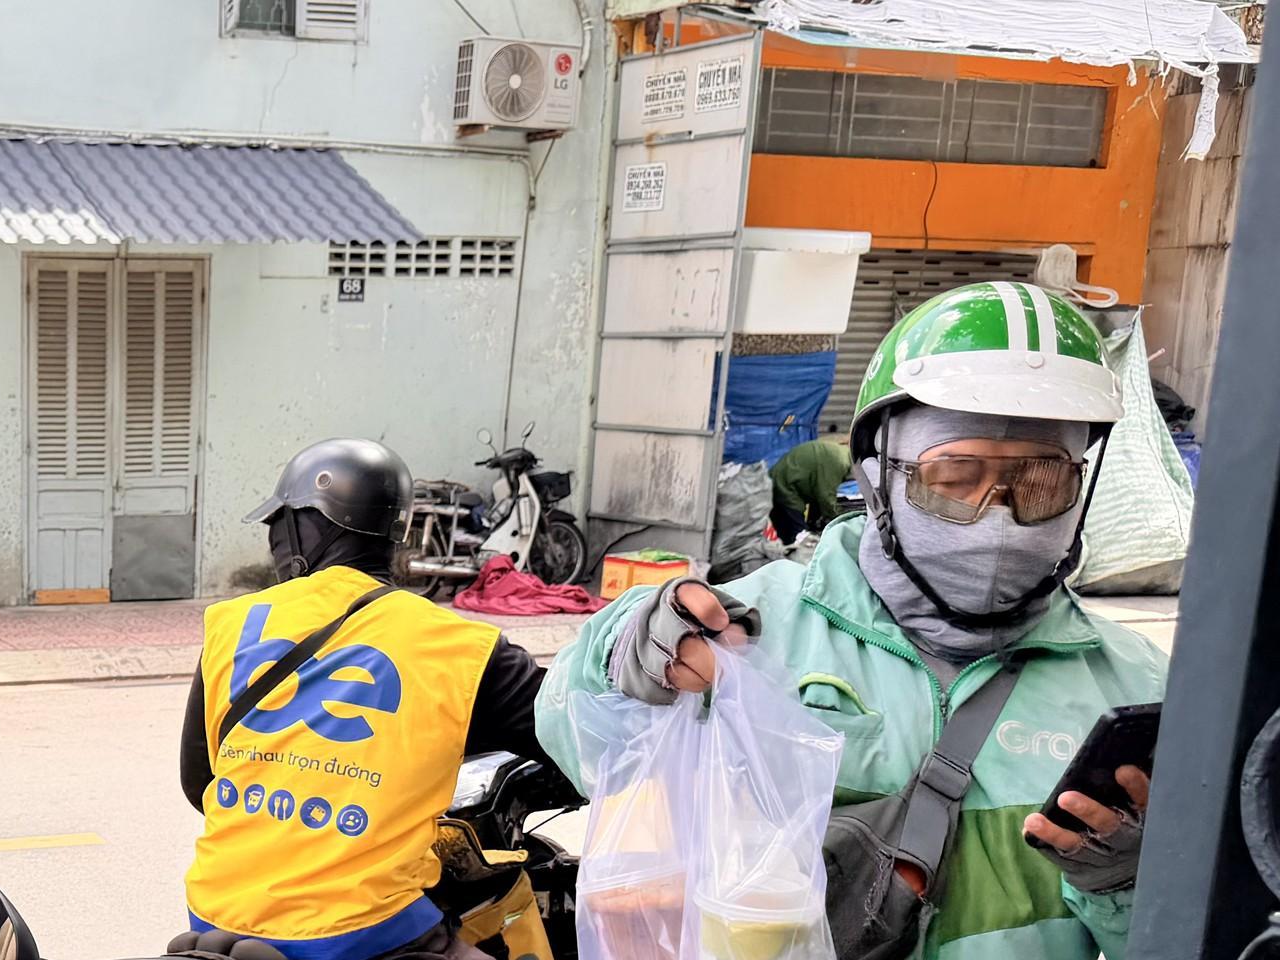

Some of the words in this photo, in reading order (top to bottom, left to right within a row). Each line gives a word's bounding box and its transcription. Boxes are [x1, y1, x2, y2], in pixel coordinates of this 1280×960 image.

[553, 78, 568, 90] LG
[342, 279, 362, 294] 68
[229, 603, 402, 742] be
[996, 720, 1083, 761] Gra
[288, 752, 320, 772] trọn
[324, 756, 383, 788] đường
